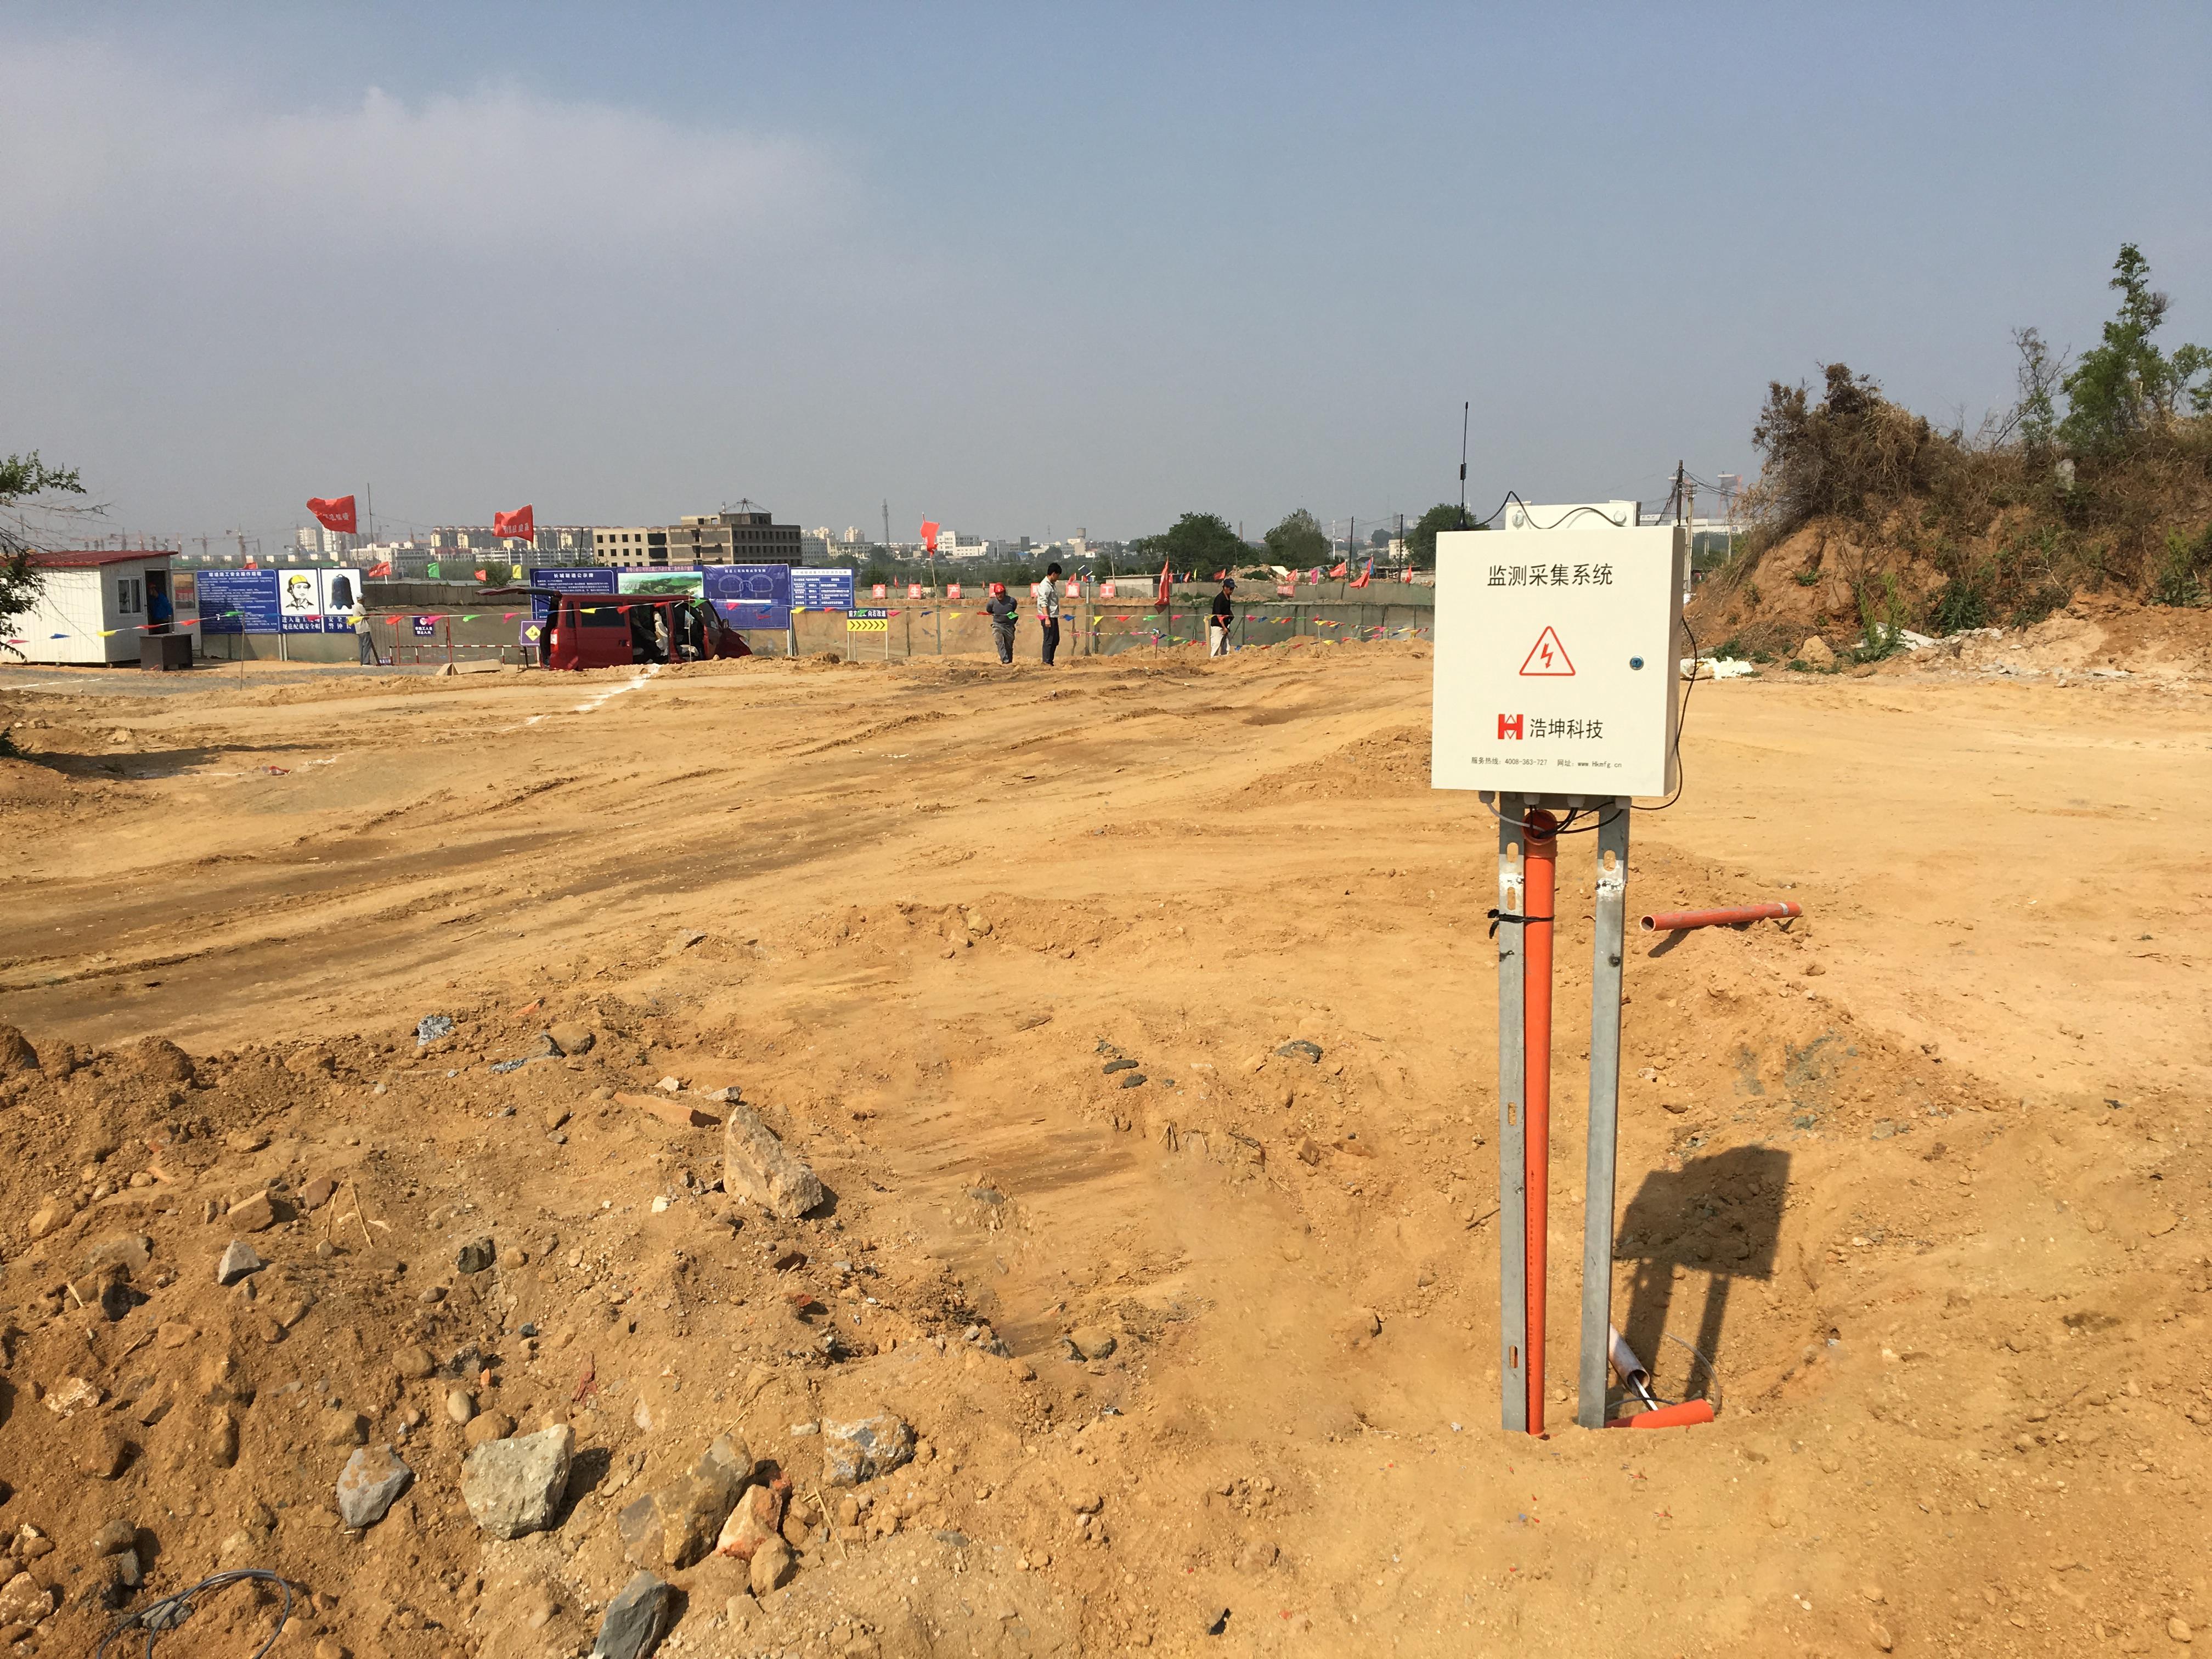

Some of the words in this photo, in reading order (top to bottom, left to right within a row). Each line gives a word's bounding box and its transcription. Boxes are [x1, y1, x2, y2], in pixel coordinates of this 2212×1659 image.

[1487, 563, 1613, 586] 监测采集系统
[874, 586, 884, 597] 全
[910, 585, 919, 597] 生
[1101, 585, 1113, 596] 工
[1530, 718, 1603, 740] 浩坤科技
